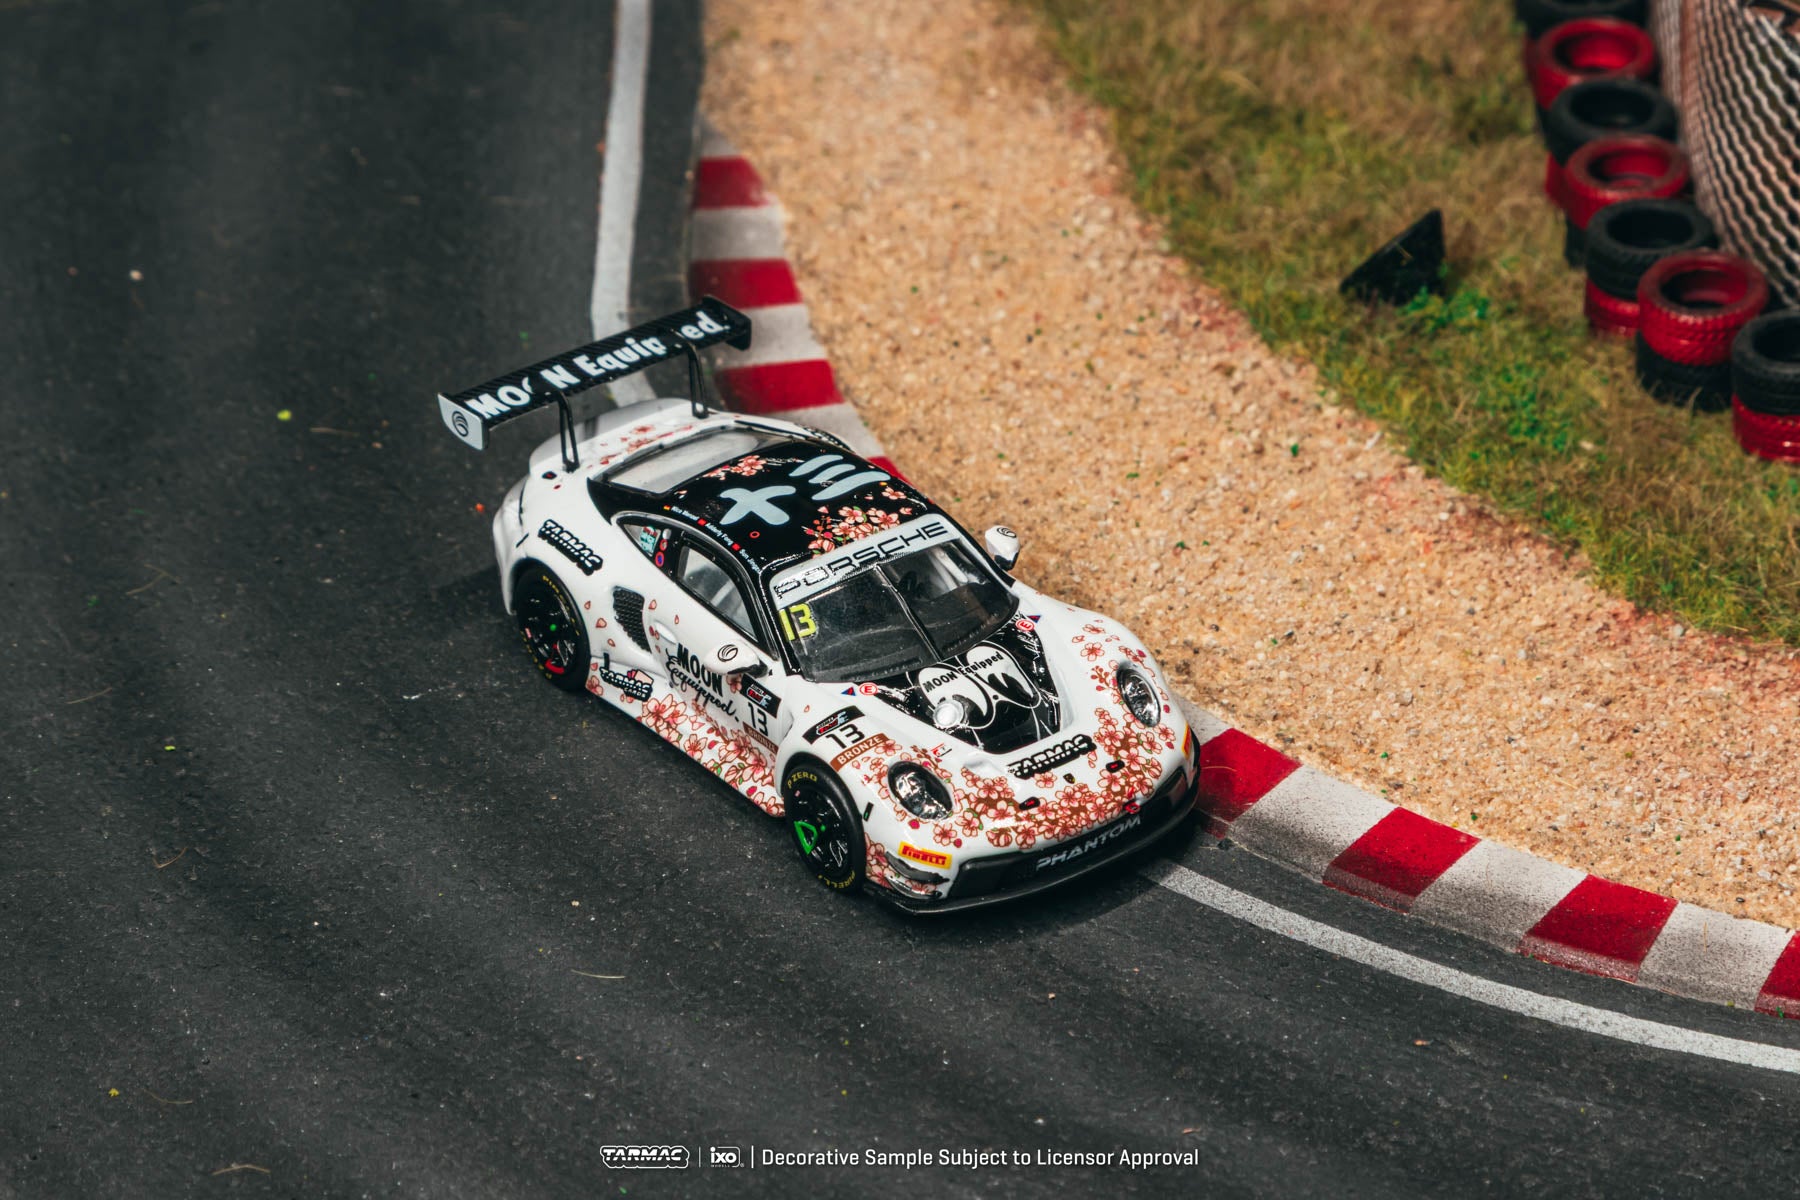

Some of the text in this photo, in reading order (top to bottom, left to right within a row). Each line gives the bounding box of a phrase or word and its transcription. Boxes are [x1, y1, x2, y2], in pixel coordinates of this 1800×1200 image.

[465, 311, 731, 419] MON Equiped.
[539, 520, 602, 572] TARMAC
[774, 521, 949, 600] PORSCHE
[780, 603, 817, 641] 13
[600, 668, 652, 695] TARMAC
[676, 642, 724, 698] MOON
[922, 651, 1005, 693] MOON Equipped
[747, 701, 769, 737] 13
[825, 723, 866, 750] 13
[836, 735, 883, 765] BRONZE
[1011, 735, 1093, 778] TARMAC
[792, 771, 817, 783] ZERO
[1035, 816, 1142, 872] PHANTOM
